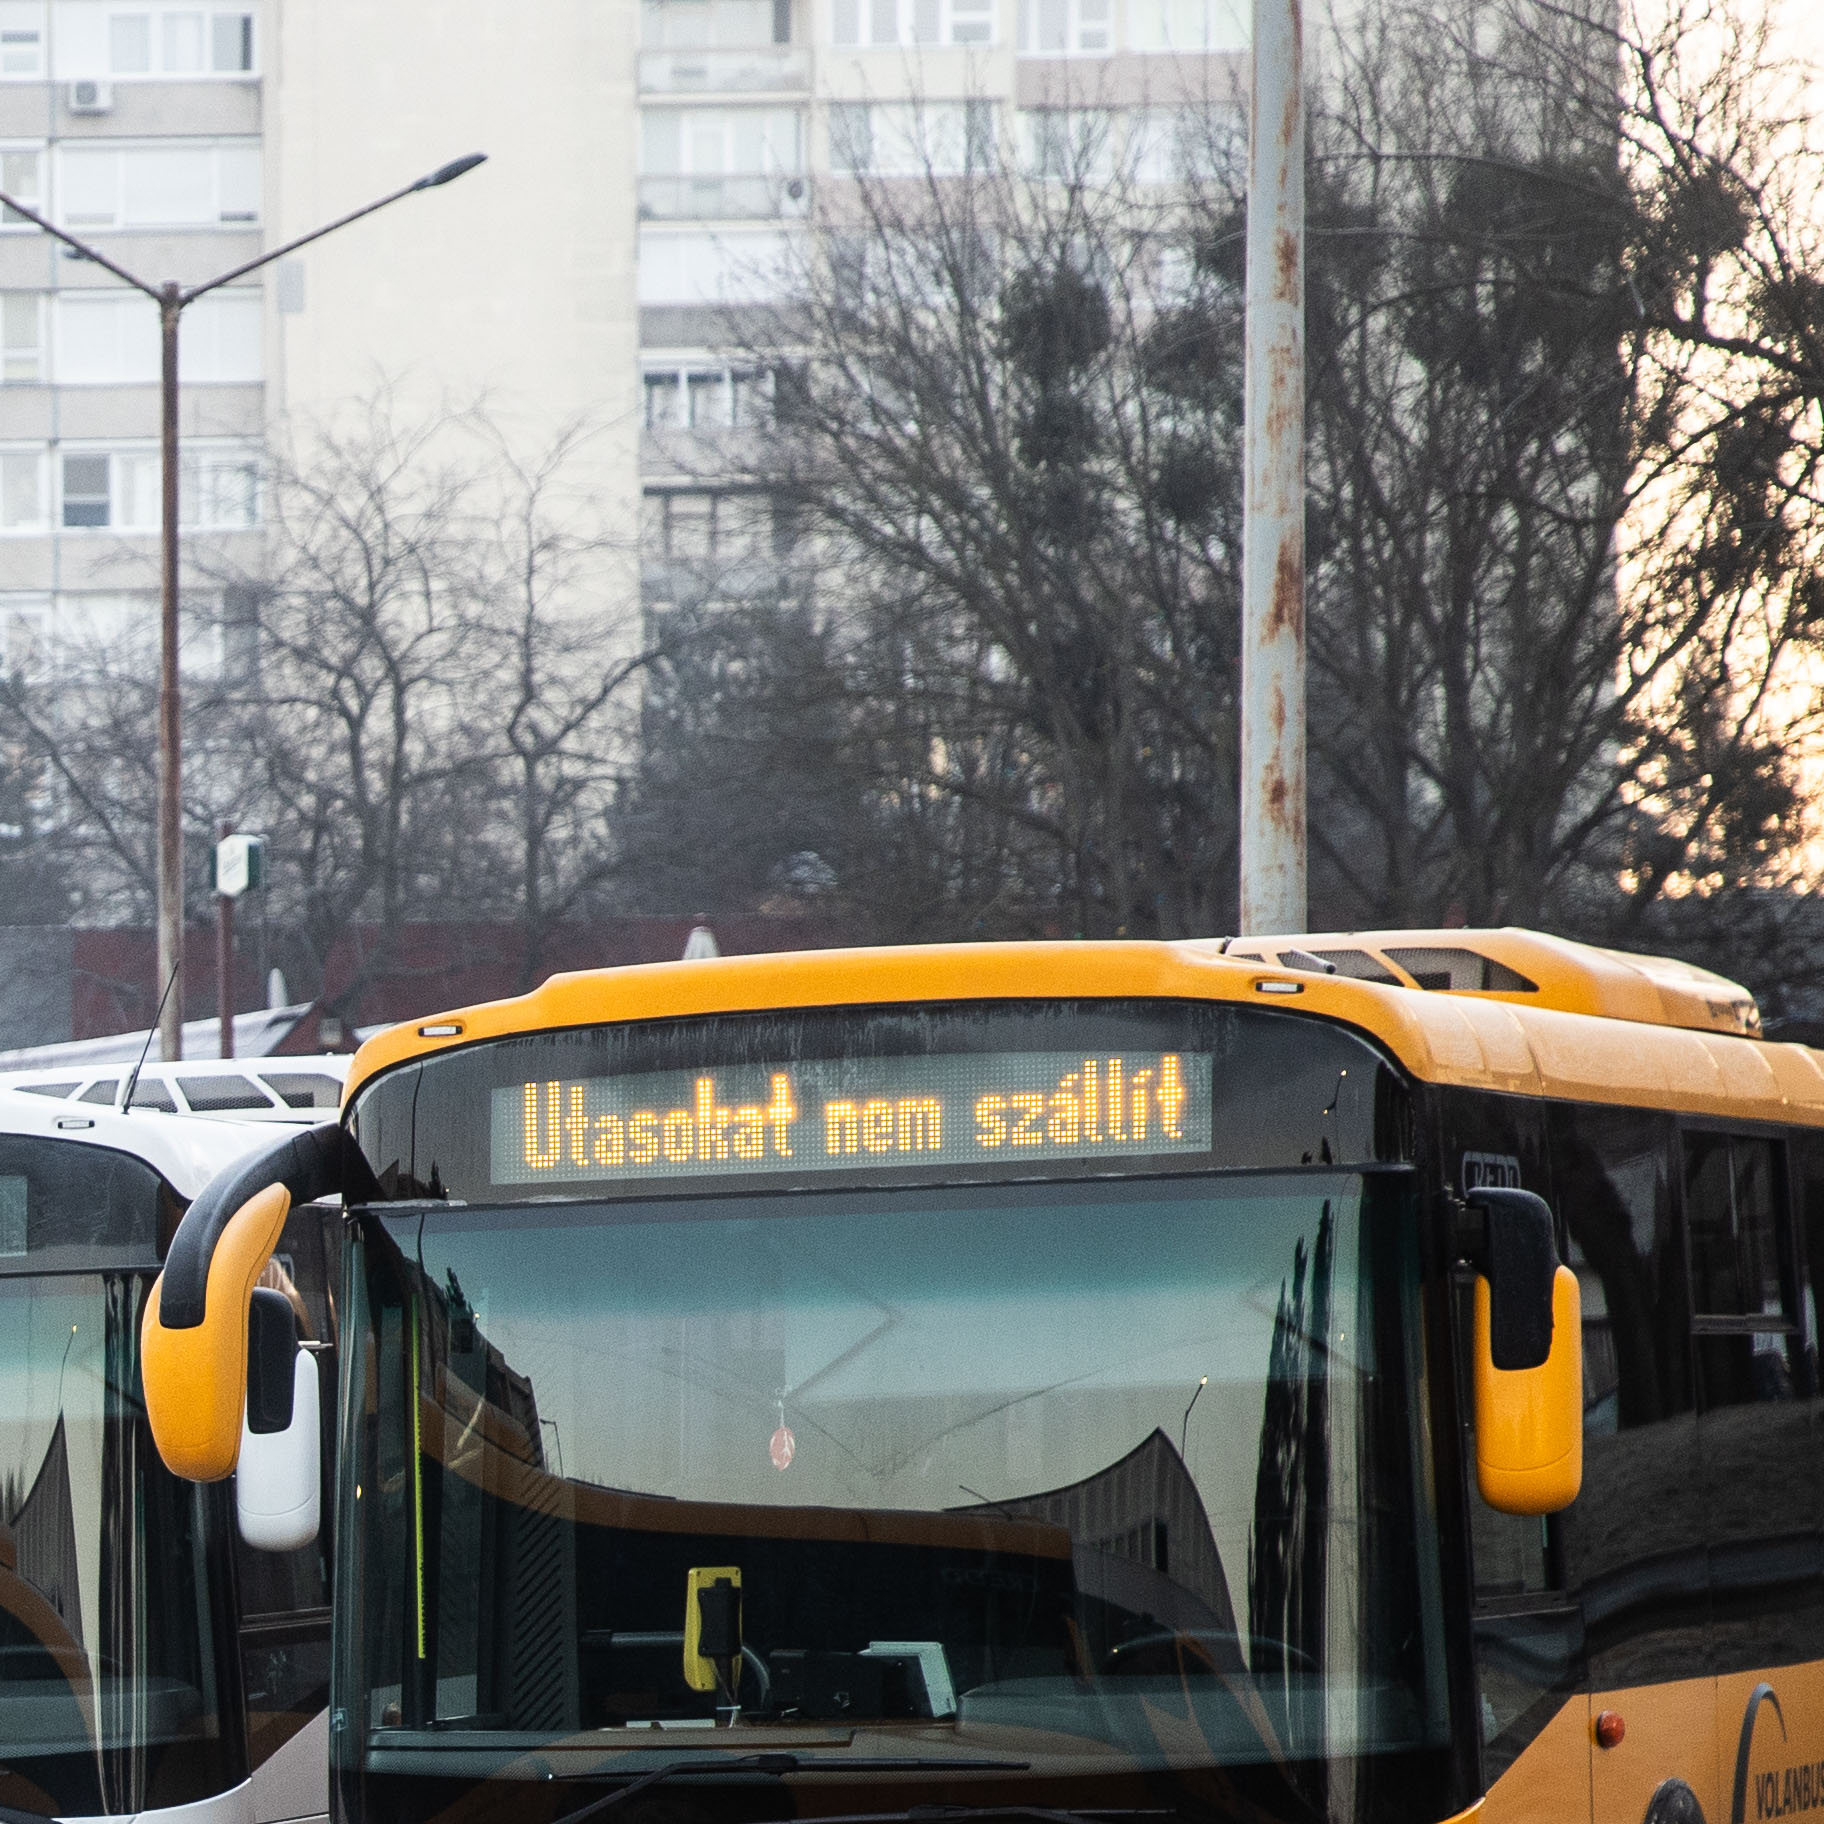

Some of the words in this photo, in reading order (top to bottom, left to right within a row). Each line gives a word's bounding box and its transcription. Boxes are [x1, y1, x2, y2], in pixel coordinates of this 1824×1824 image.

[523, 1073, 796, 1169] Utasokat
[825, 1098, 942, 1154] nem
[975, 1054, 1184, 1148] szállít
